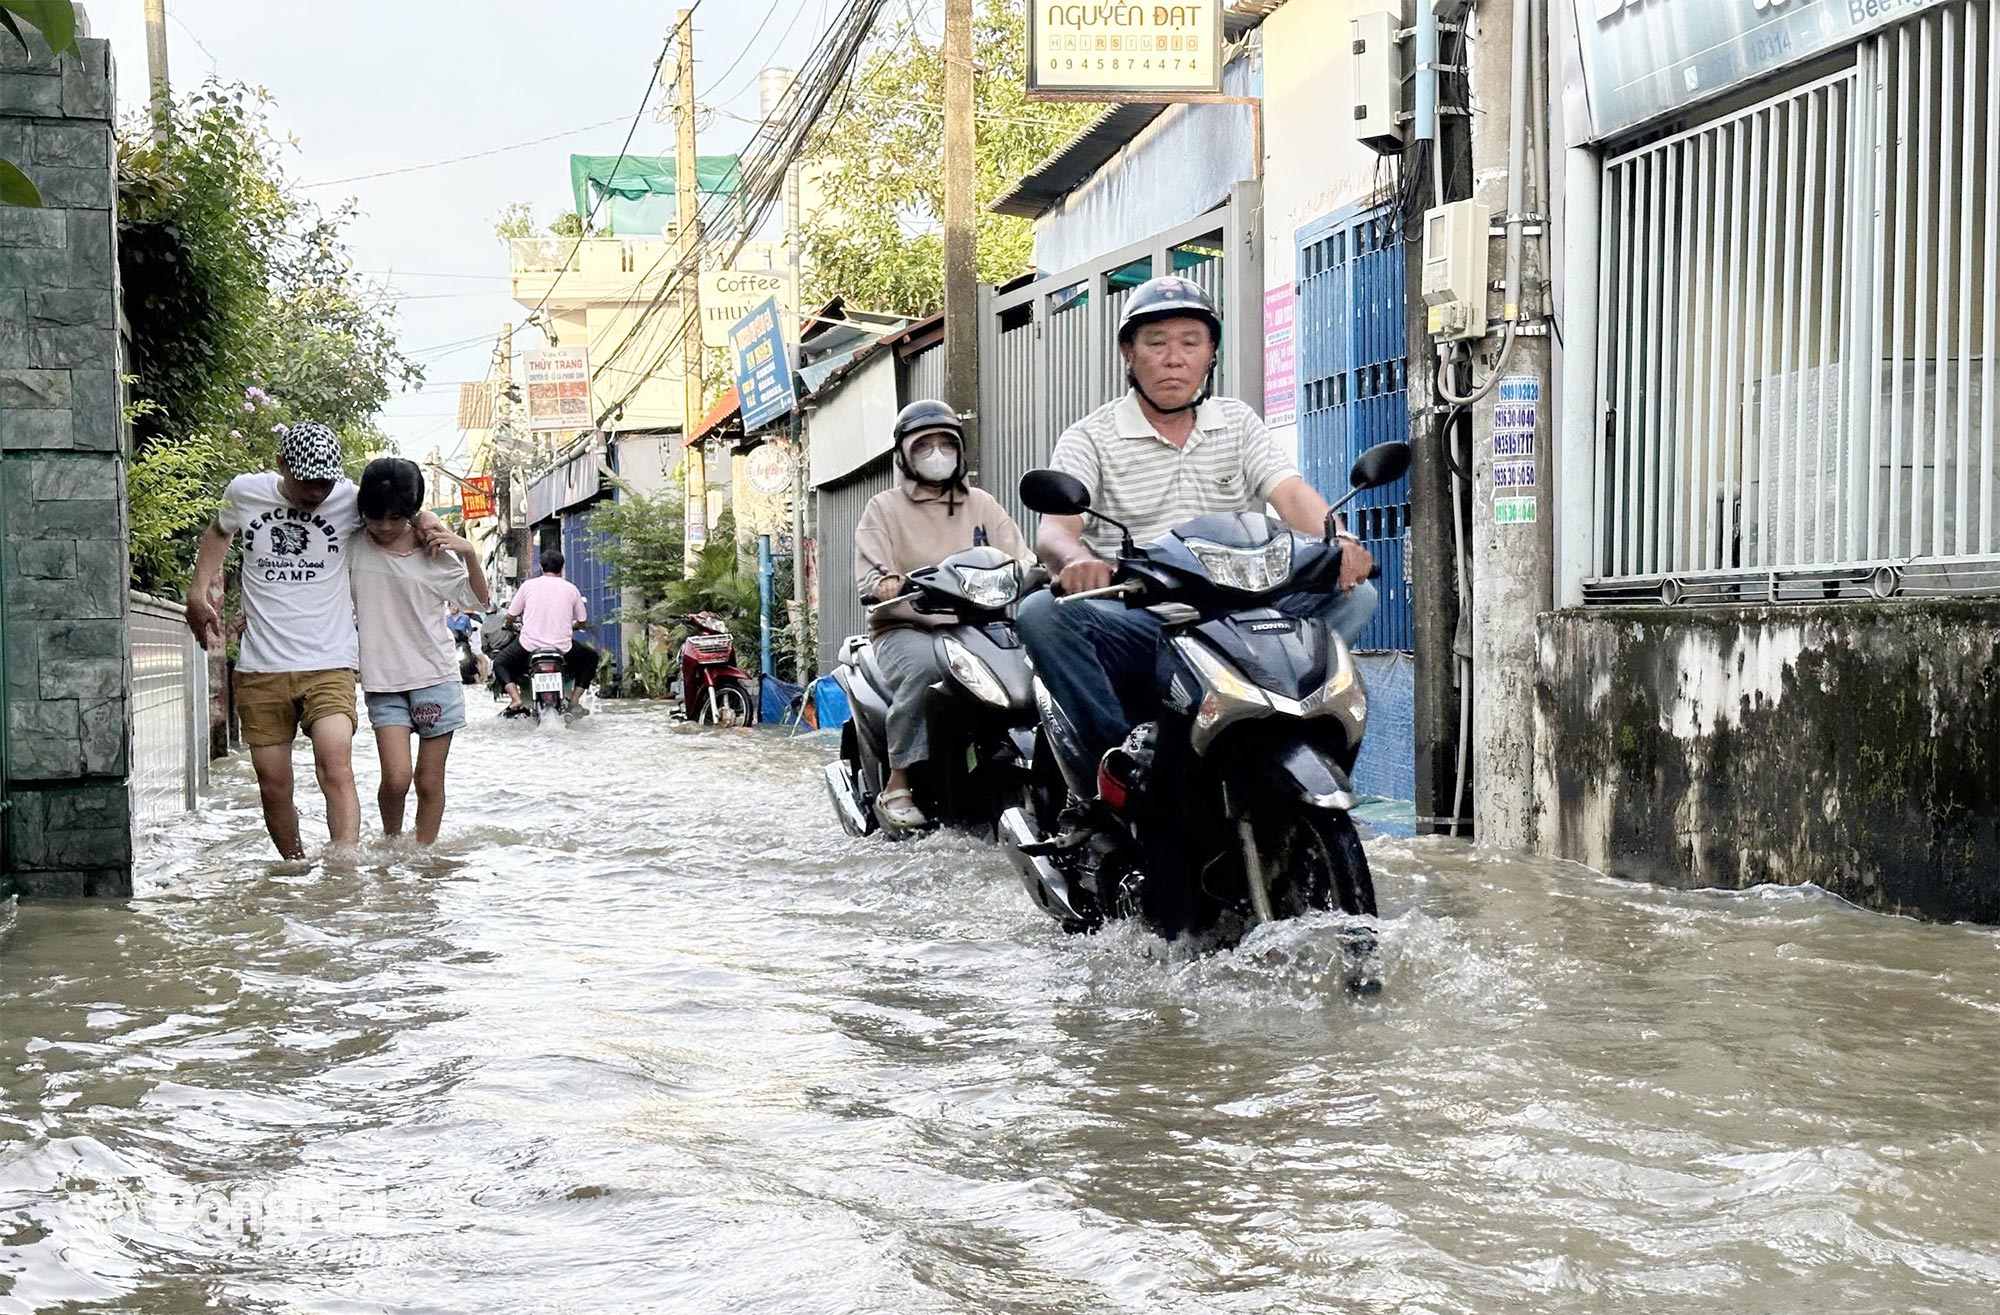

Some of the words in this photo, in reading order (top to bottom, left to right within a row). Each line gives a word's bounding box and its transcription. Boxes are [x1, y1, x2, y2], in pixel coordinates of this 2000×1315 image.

[1152, 5, 1202, 31] ĐẠT
[716, 275, 781, 293] Coffee
[554, 359, 583, 370] TRANG
[245, 507, 338, 553] ABERCROMBIE
[265, 569, 316, 581] CAMP
[1251, 622, 1291, 632] HONDA
